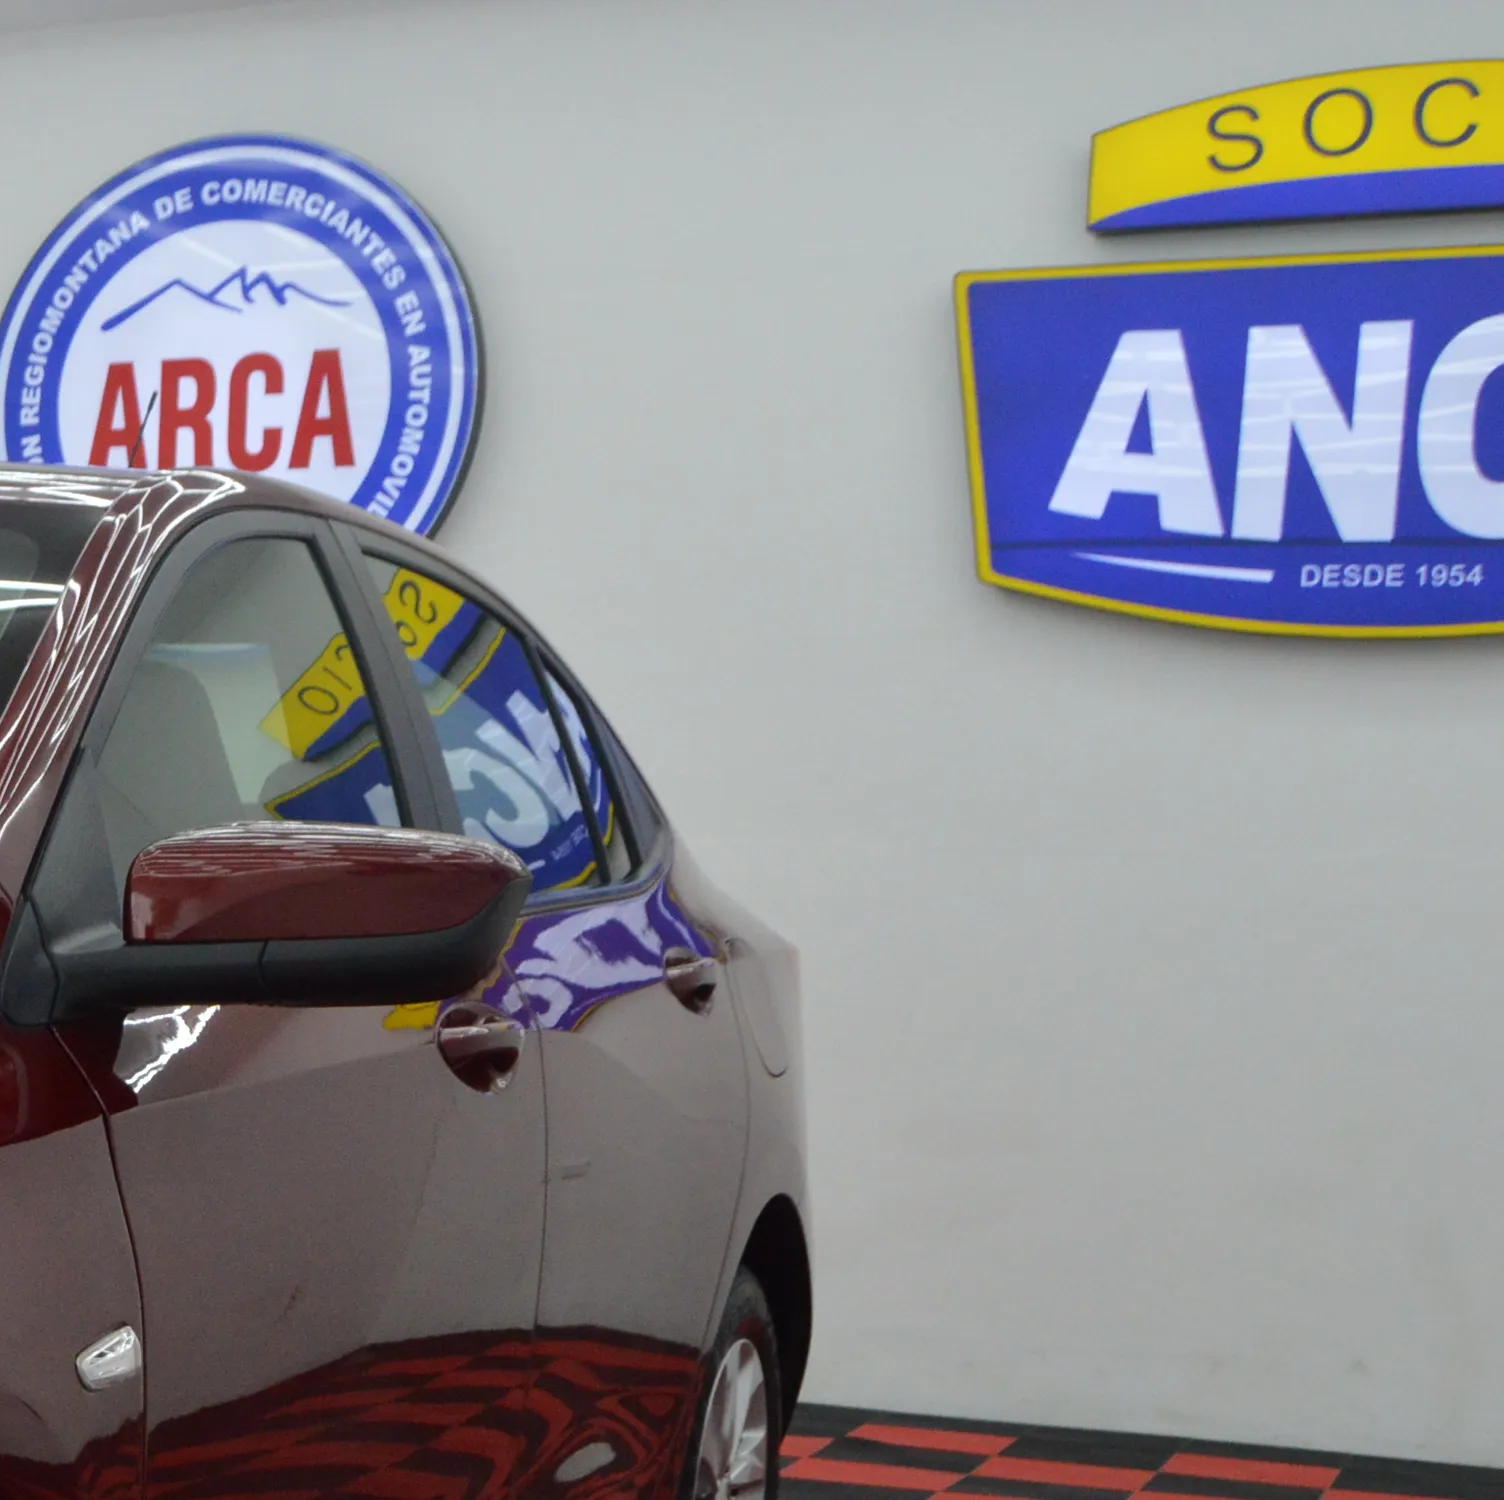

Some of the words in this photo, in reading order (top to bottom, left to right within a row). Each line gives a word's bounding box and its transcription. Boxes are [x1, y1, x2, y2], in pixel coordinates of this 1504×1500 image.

[1206, 77, 1481, 173] SOC
[20, 210, 151, 428] REGIOMONTANA
[153, 187, 194, 221] DE
[200, 178, 406, 290] COMERCIANTES
[394, 289, 427, 337] EN
[87, 347, 356, 472] ARCA
[1300, 564, 1404, 588] DESDE
[1416, 564, 1484, 588] 1954
